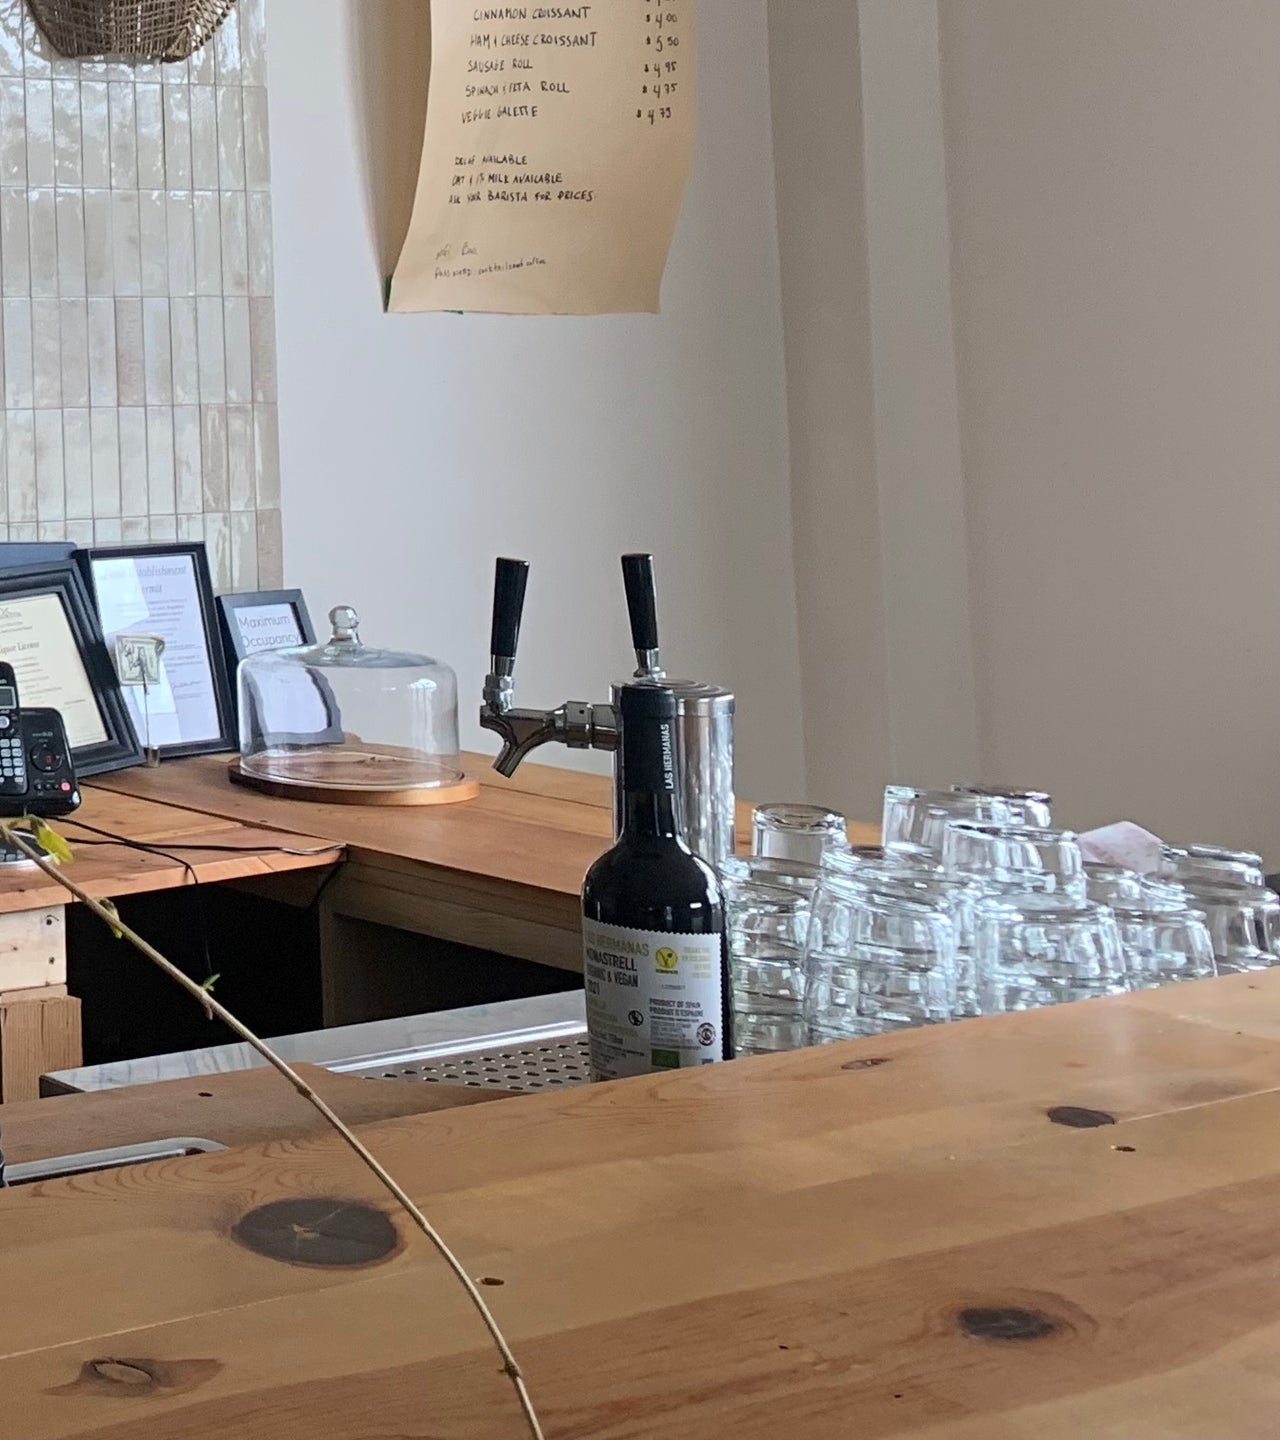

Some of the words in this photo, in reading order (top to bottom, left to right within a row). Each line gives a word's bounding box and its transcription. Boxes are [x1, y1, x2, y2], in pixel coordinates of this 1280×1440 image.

[473, 7, 527, 21] CINNAMON
[532, 6, 592, 19] CROISSANT
[470, 34, 490, 49] HAM
[502, 33, 529, 47] CHEESE
[532, 32, 598, 47] CROISSANT
[467, 60, 505, 72] SAUSAGE
[512, 58, 534, 70] ROLL
[465, 84, 499, 97] SPINACH
[508, 81, 532, 92] FETA
[540, 80, 570, 93] ROLL
[462, 109, 491, 124] VEGGIE
[496, 106, 538, 118] GALETTE
[488, 173, 510, 184] MILK
[512, 172, 563, 184] AVAILABLE
[488, 190, 528, 202] BARISTA
[534, 191, 552, 201] FOR
[238, 615, 292, 629] Maximum
[241, 634, 300, 648] Occupancy
[661, 724, 673, 772] HERMANAS
[665, 772, 674, 790] LAS
[598, 936, 650, 956] HERMANAS
[614, 972, 639, 988] VEGAN
[649, 998, 676, 1007] PRODUCT
[677, 1000, 684, 1008] OF
